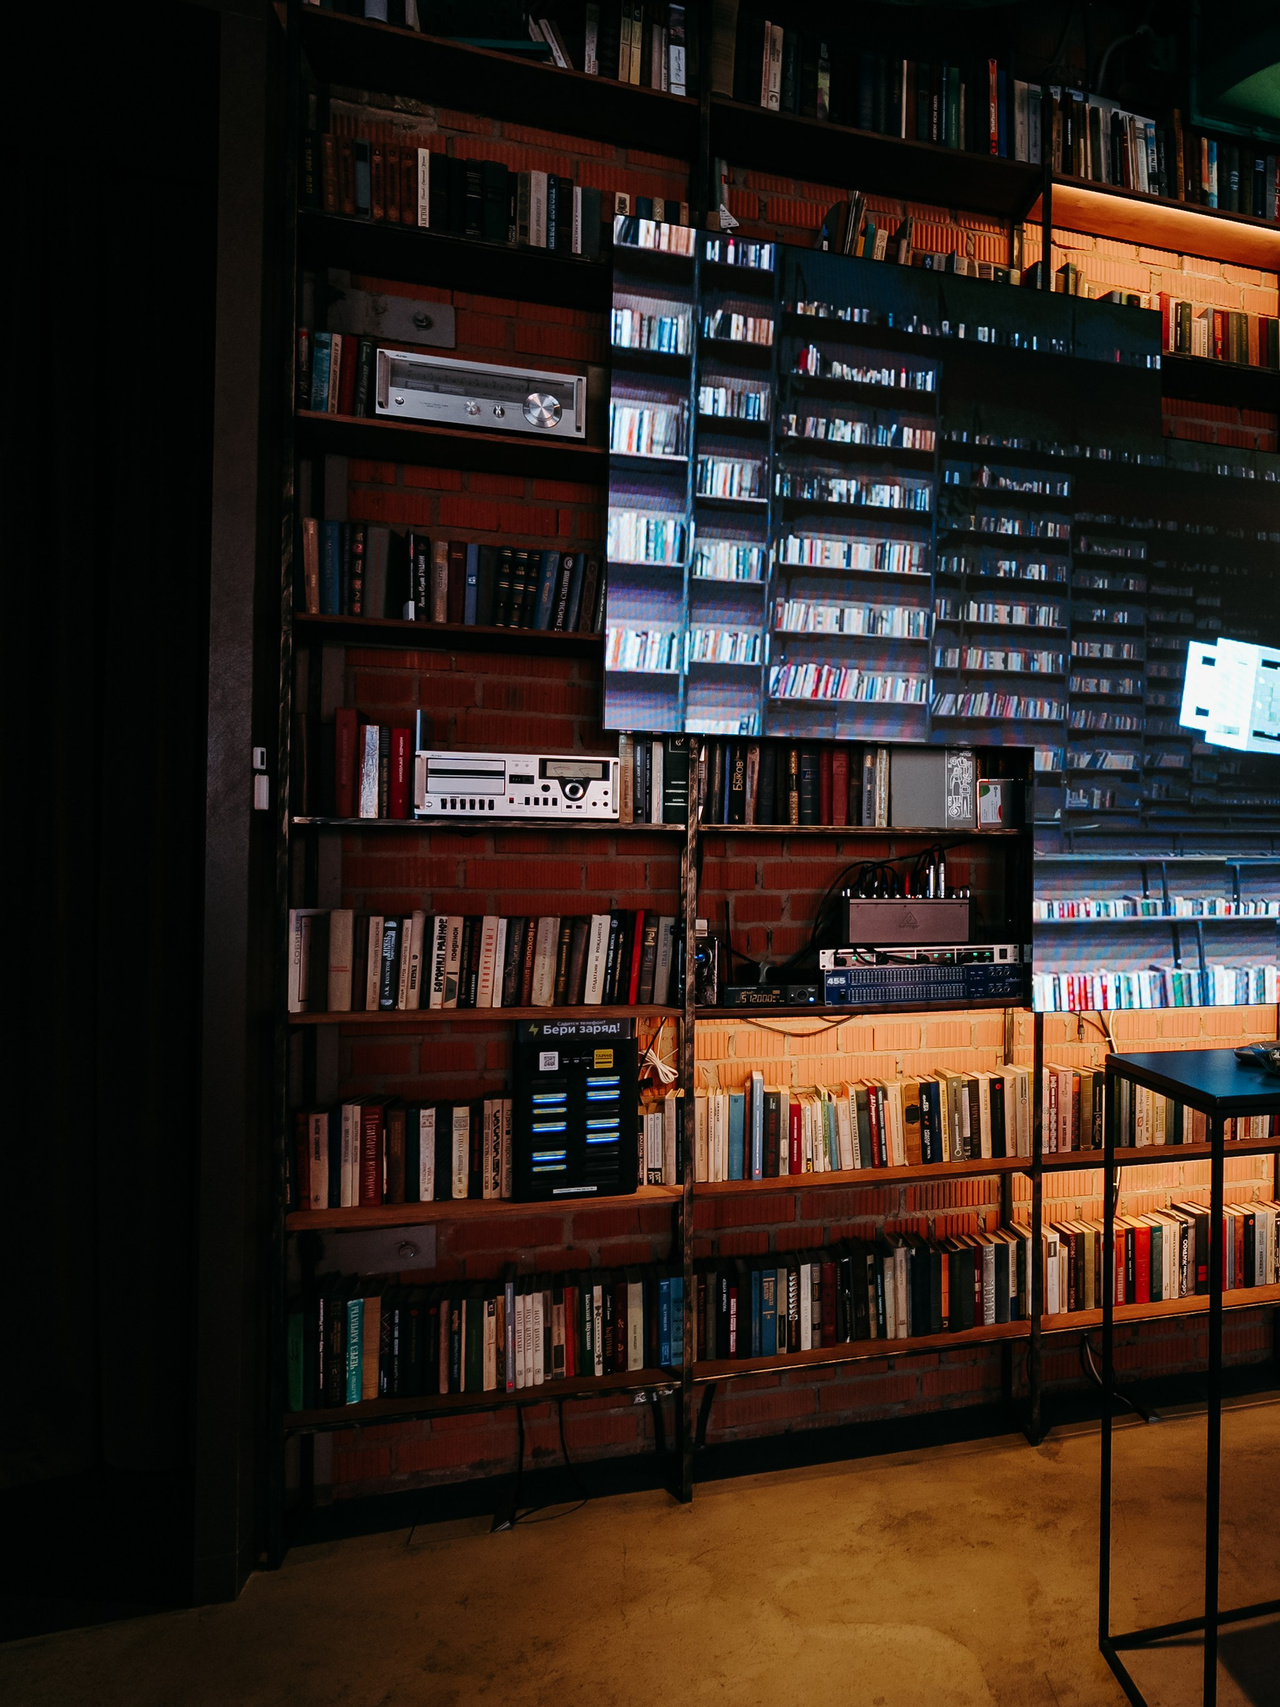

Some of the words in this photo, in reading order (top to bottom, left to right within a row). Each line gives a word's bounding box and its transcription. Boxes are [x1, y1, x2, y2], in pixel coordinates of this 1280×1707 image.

[732, 761, 744, 791] БЫКОВ
[436, 918, 447, 951] РАЙНОВ
[451, 926, 459, 962] поединок
[523, 931, 534, 968] ШОЛОХОВ
[433, 953, 445, 993] БОГОМИЛ
[522, 969, 530, 1001] МИХАИЛ
[826, 977, 846, 985] 455
[543, 1025, 576, 1036] Бери
[579, 1023, 621, 1035] заряд!
[365, 1124, 377, 1159] ГВАРДИЯ
[365, 1161, 376, 1199] МОЛОДАЯ
[1180, 1266, 1188, 1295] Себастьян
[350, 1306, 359, 1342] КАРПАТЫ
[350, 1345, 358, 1370] ЧЕРЕЗ
